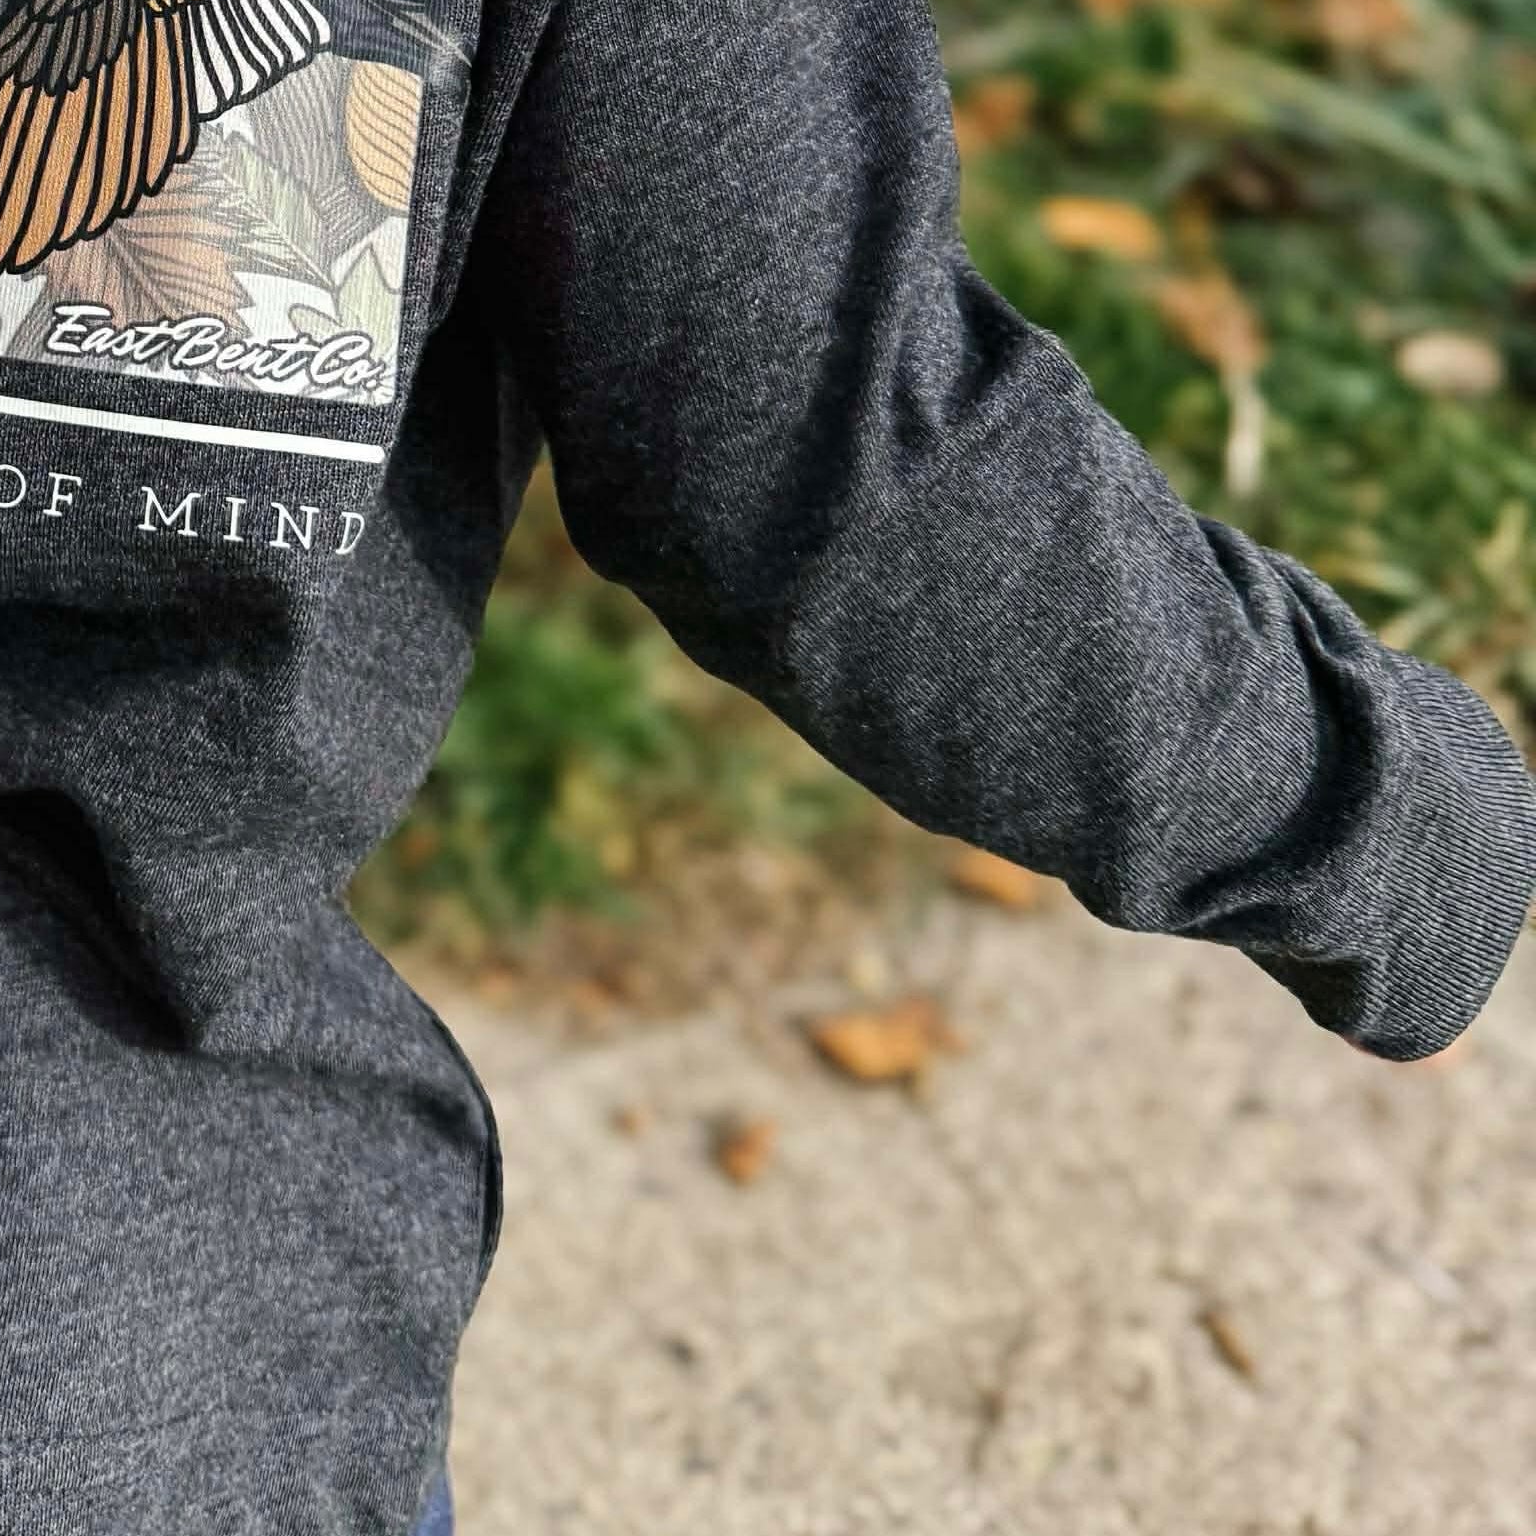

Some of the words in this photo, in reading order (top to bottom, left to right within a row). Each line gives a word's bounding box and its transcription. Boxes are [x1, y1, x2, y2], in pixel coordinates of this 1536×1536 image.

[49, 304, 172, 360] East
[171, 318, 314, 380] Bent
[310, 333, 384, 389] Co.
[137, 486, 366, 556] MIND
